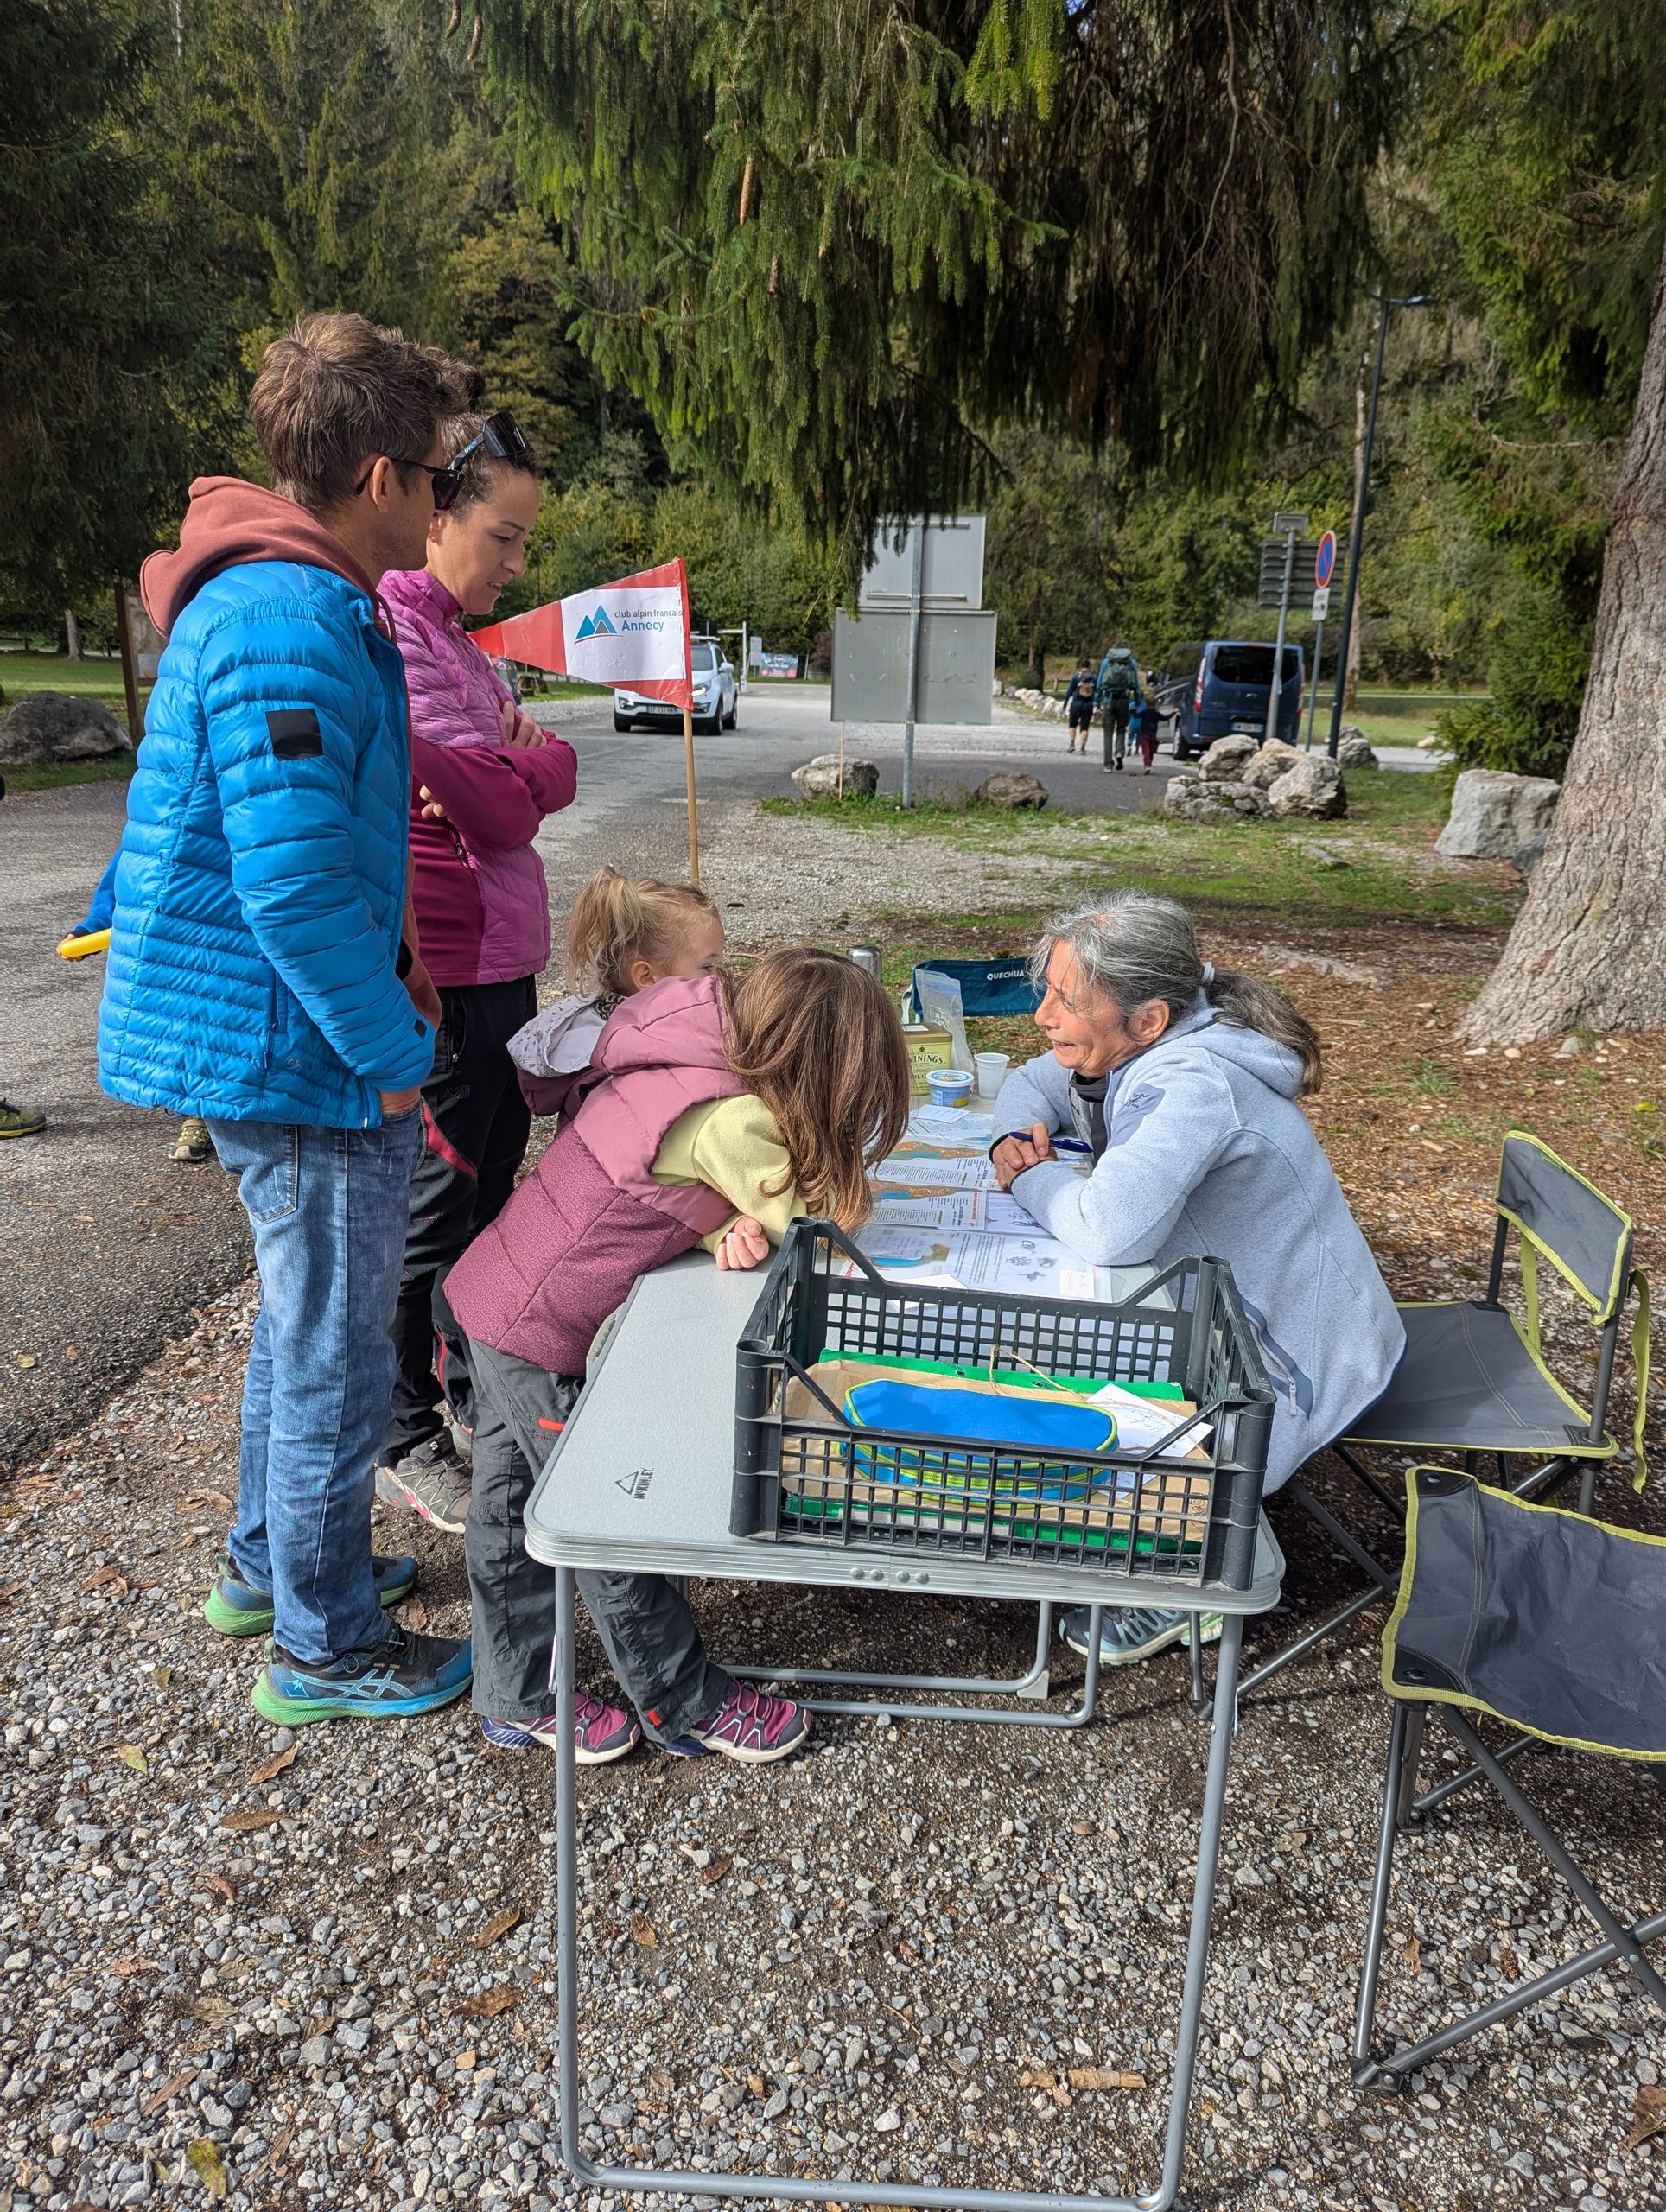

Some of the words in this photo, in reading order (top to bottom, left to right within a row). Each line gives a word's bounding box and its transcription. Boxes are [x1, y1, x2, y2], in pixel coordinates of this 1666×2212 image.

[633, 609, 652, 619] alpin
[653, 608, 683, 618] français
[621, 620, 664, 632] Annecy
[986, 969, 1025, 981] QUECHUA
